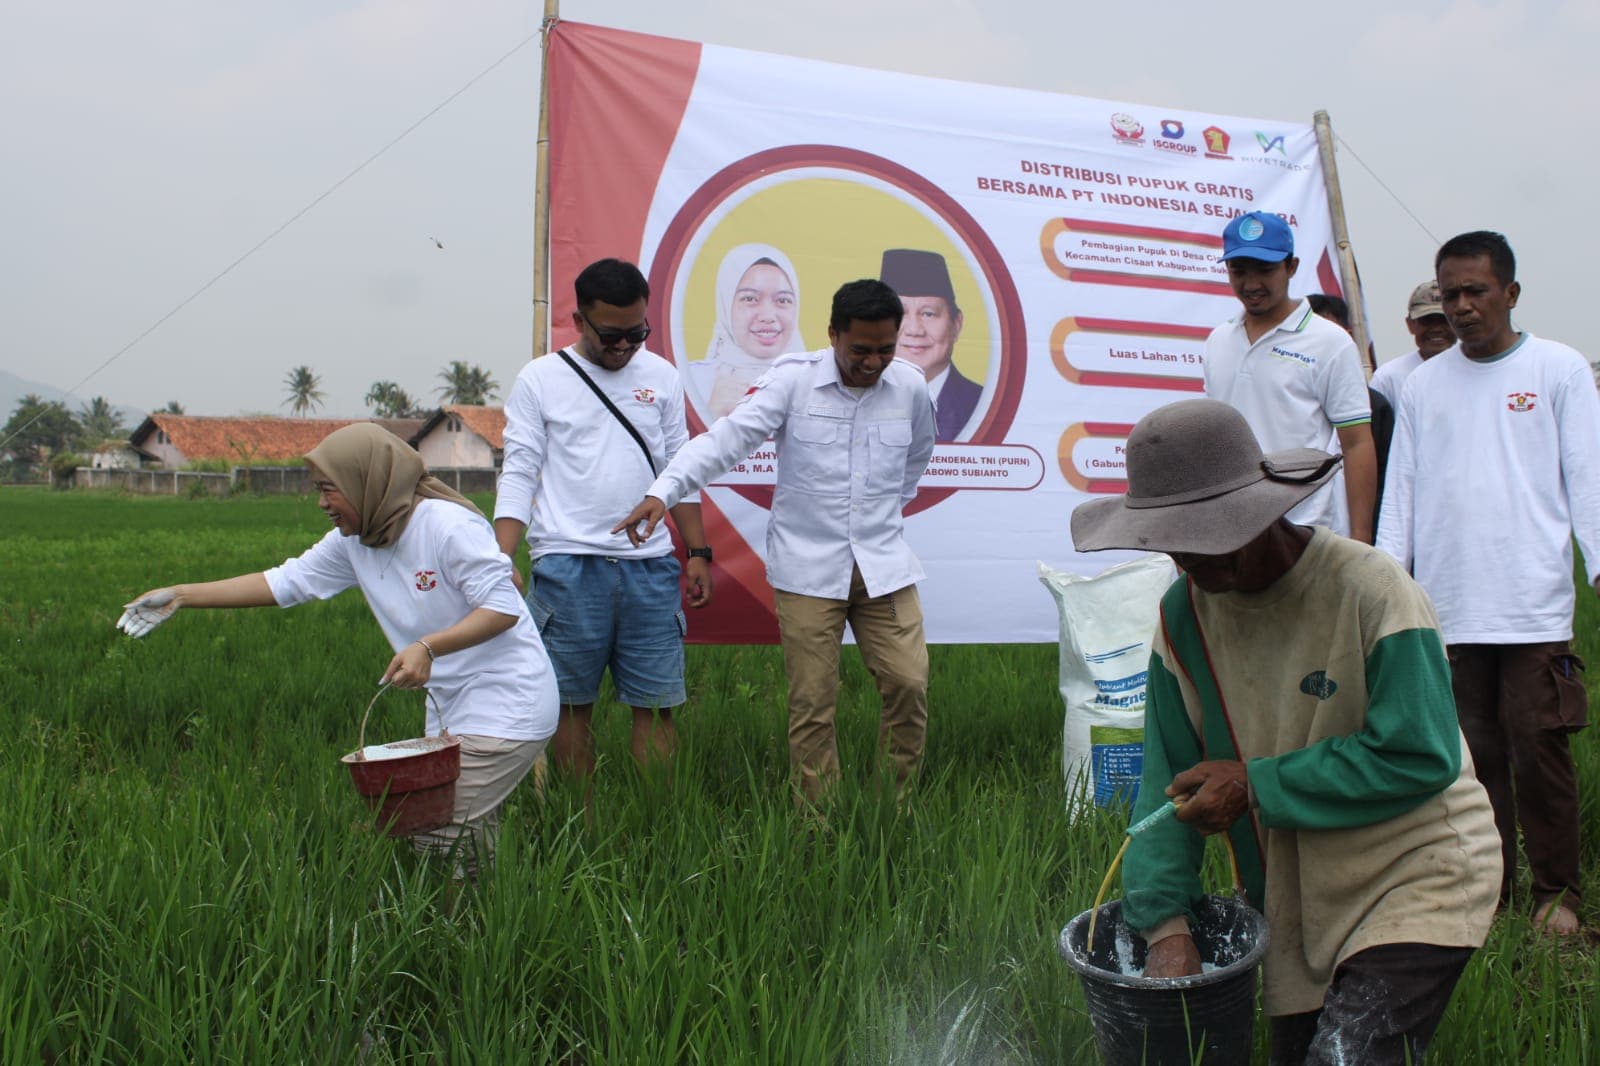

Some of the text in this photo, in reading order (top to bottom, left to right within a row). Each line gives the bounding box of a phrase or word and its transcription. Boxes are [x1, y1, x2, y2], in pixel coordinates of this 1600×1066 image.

[1153, 139, 1197, 153] ISGROUP
[1021, 160, 1254, 201] DISTRIBUSI PUPUK GRATIS
[977, 177, 1067, 199] BERSAMA
[1072, 189, 1094, 202] PT
[1100, 192, 1199, 214] INDONESIA
[1081, 240, 1135, 252] Pembagian
[1138, 245, 1166, 256] Pupuk
[1170, 249, 1180, 257] Di
[1182, 250, 1204, 260] Desa
[1065, 251, 1121, 263] Kecamatan
[1124, 256, 1154, 267] Cisaat
[1157, 260, 1208, 272] Kabupaten
[1109, 348, 1138, 359] Luas
[1142, 350, 1177, 362] Lahan
[1181, 353, 1195, 363] 15
[753, 464, 774, 472] M.A
[930, 456, 1030, 467] JENDERAL TNI (PURN)
[961, 469, 1009, 477] SUBIANTO
